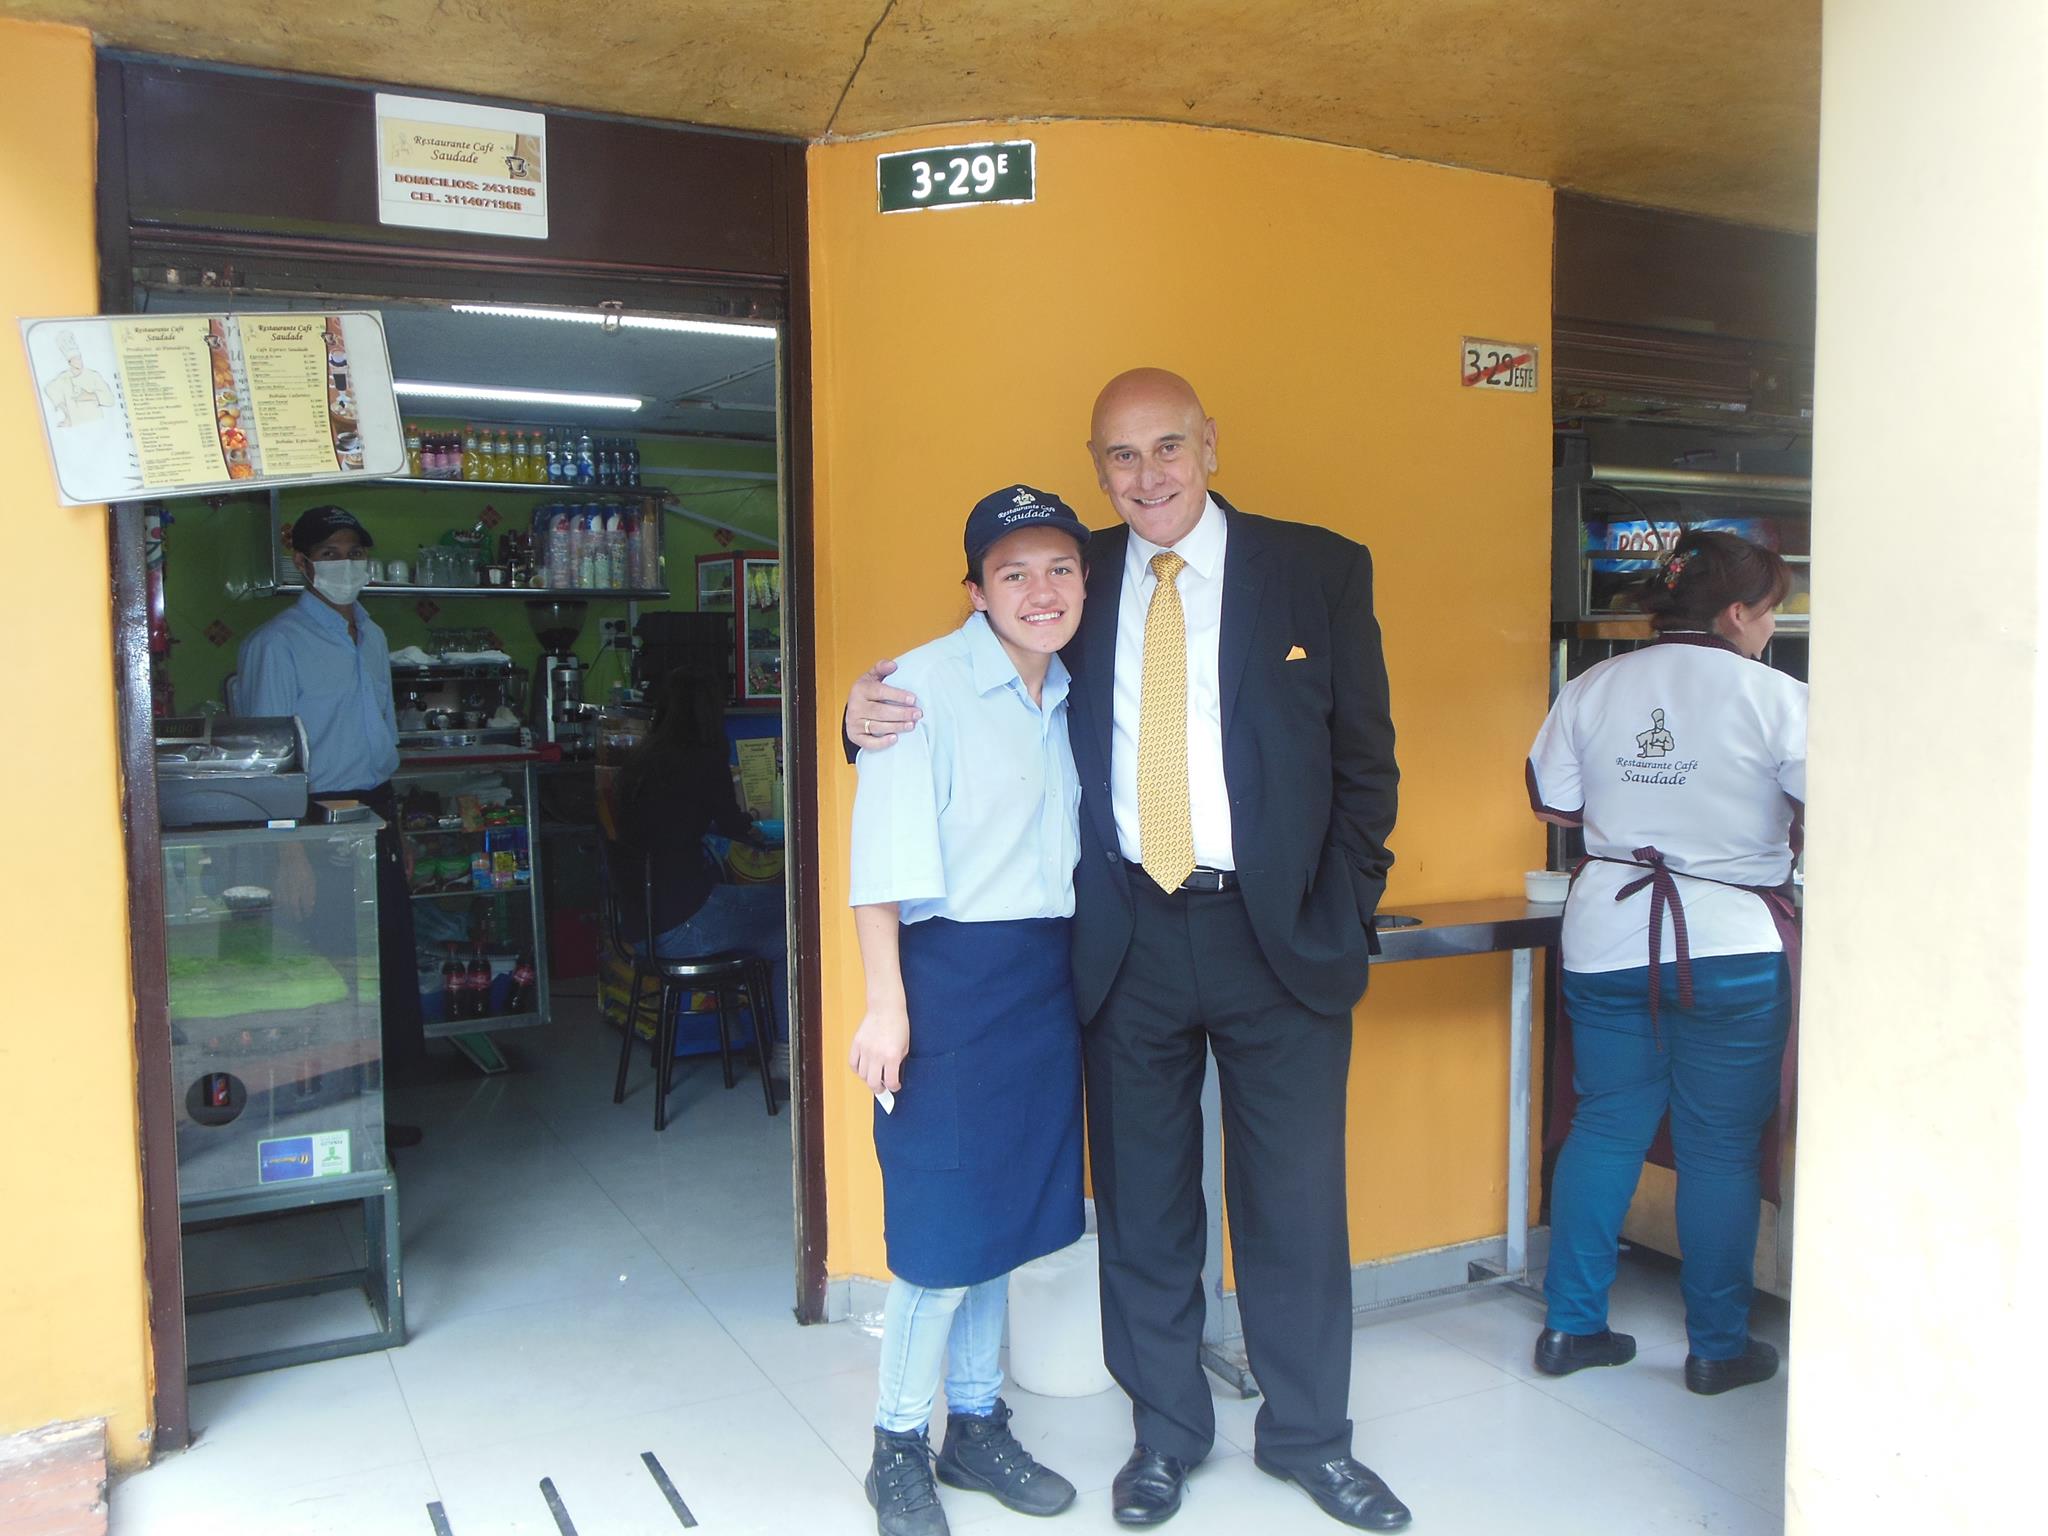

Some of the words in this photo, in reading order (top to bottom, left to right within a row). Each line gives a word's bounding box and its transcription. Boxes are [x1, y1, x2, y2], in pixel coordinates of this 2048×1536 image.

[413, 135, 471, 150] Restaurante
[472, 142, 495, 153] Café
[430, 149, 479, 164] Saudade
[394, 173, 479, 191] DOMICILIOS:
[410, 191, 442, 203] CEL.
[271, 332, 304, 341] Saudade
[997, 504, 1040, 519] Restaurante
[1003, 508, 1051, 526] Saudade
[1615, 757, 1672, 770] Restaurante
[1674, 759, 1699, 773] Café
[1620, 769, 1687, 785] Saudade
